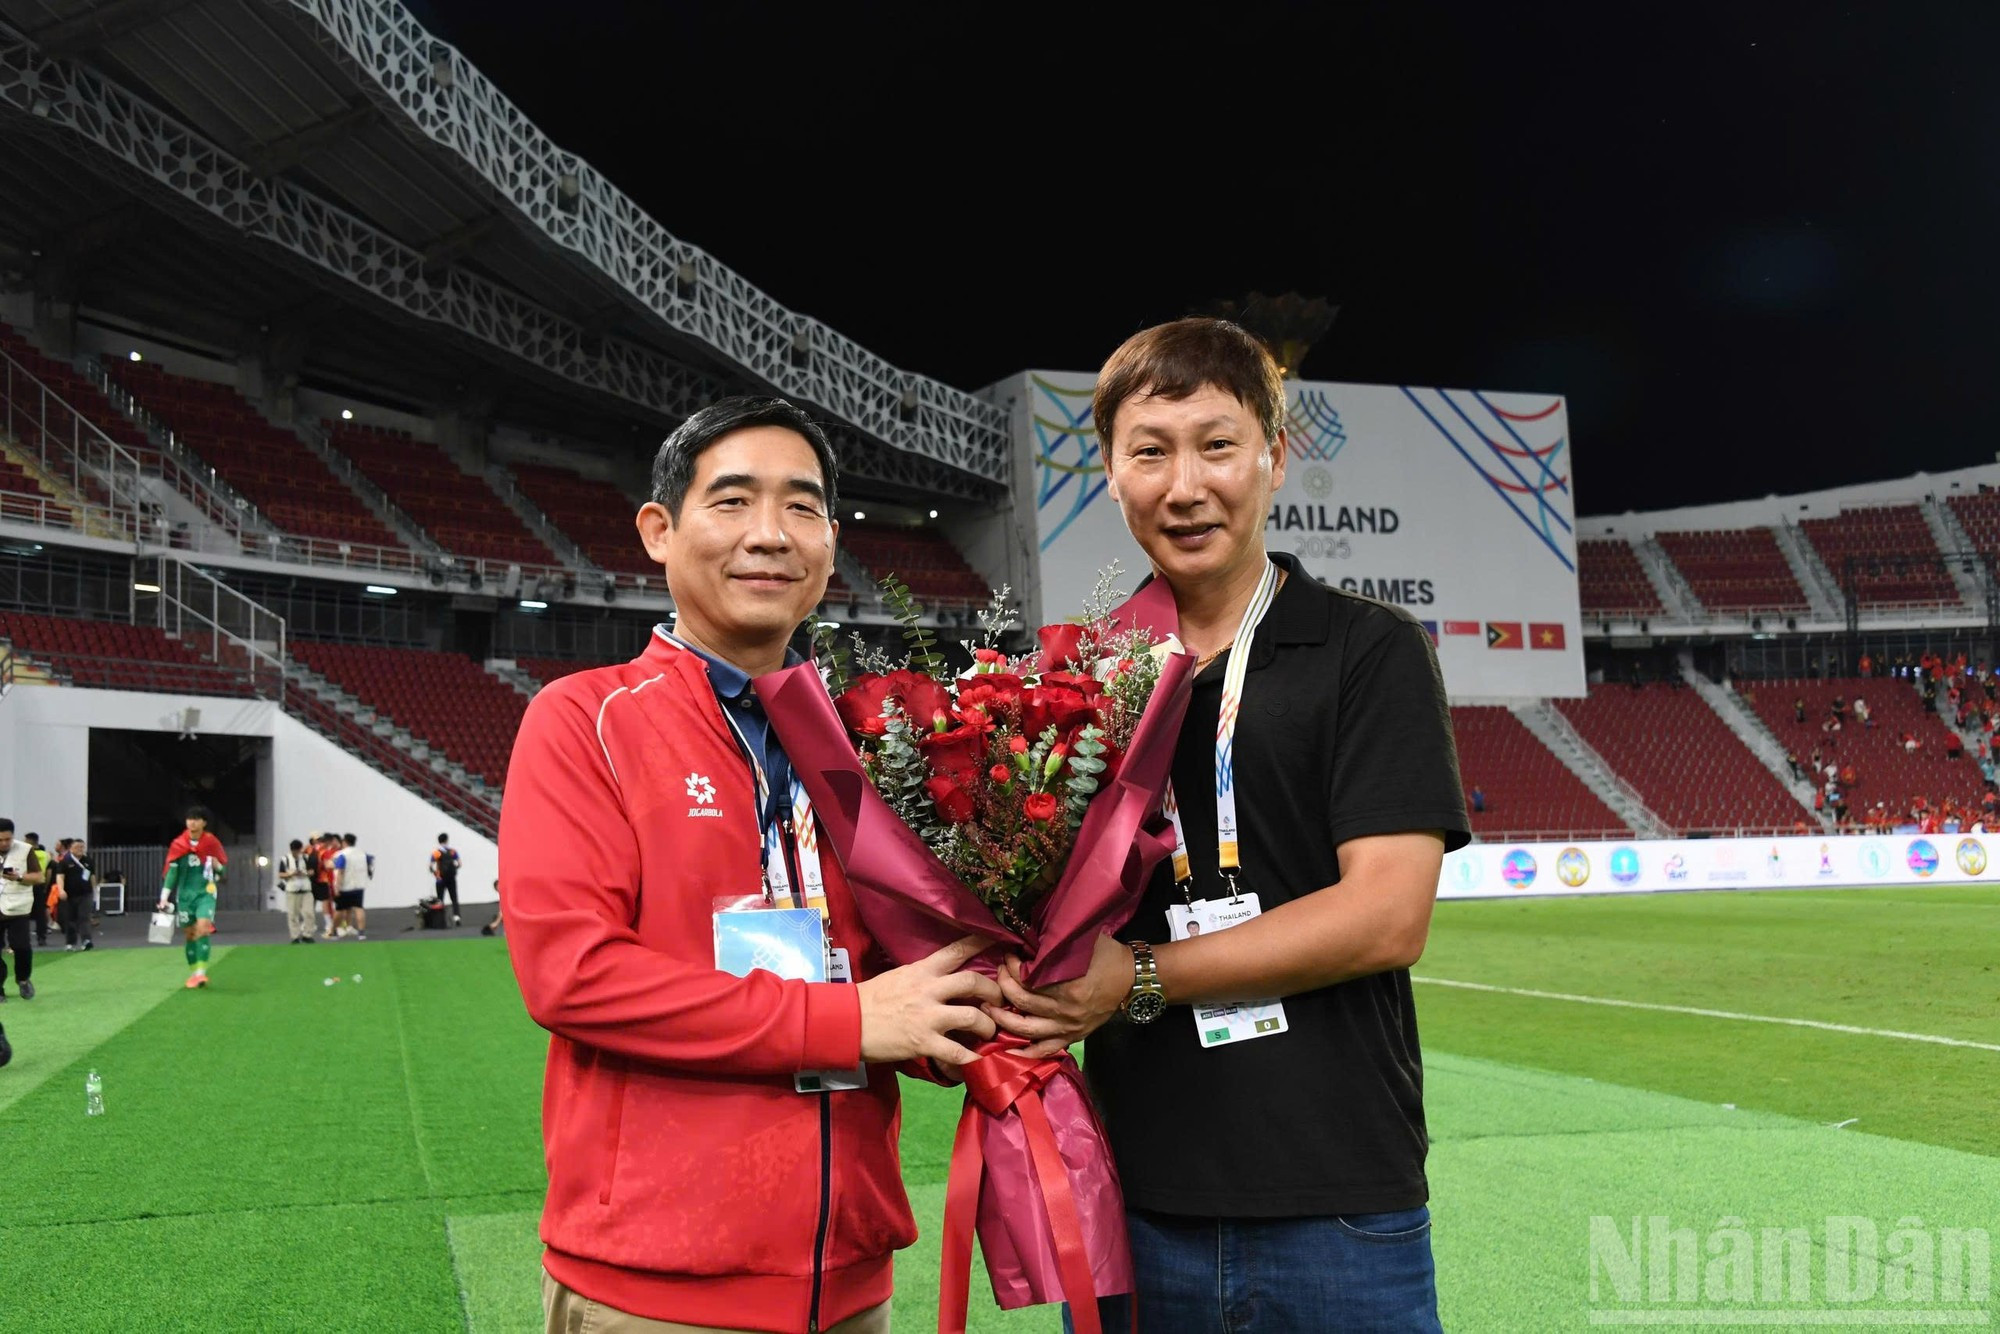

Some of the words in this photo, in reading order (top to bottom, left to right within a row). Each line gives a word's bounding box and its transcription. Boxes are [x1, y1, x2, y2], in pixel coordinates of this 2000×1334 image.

[1264, 504, 1399, 534] HAILAND
[1294, 535, 1352, 560] 2025
[1340, 576, 1434, 605] GAMES
[1218, 910, 1252, 922] THAILAND
[1214, 1031, 1222, 1040] S
